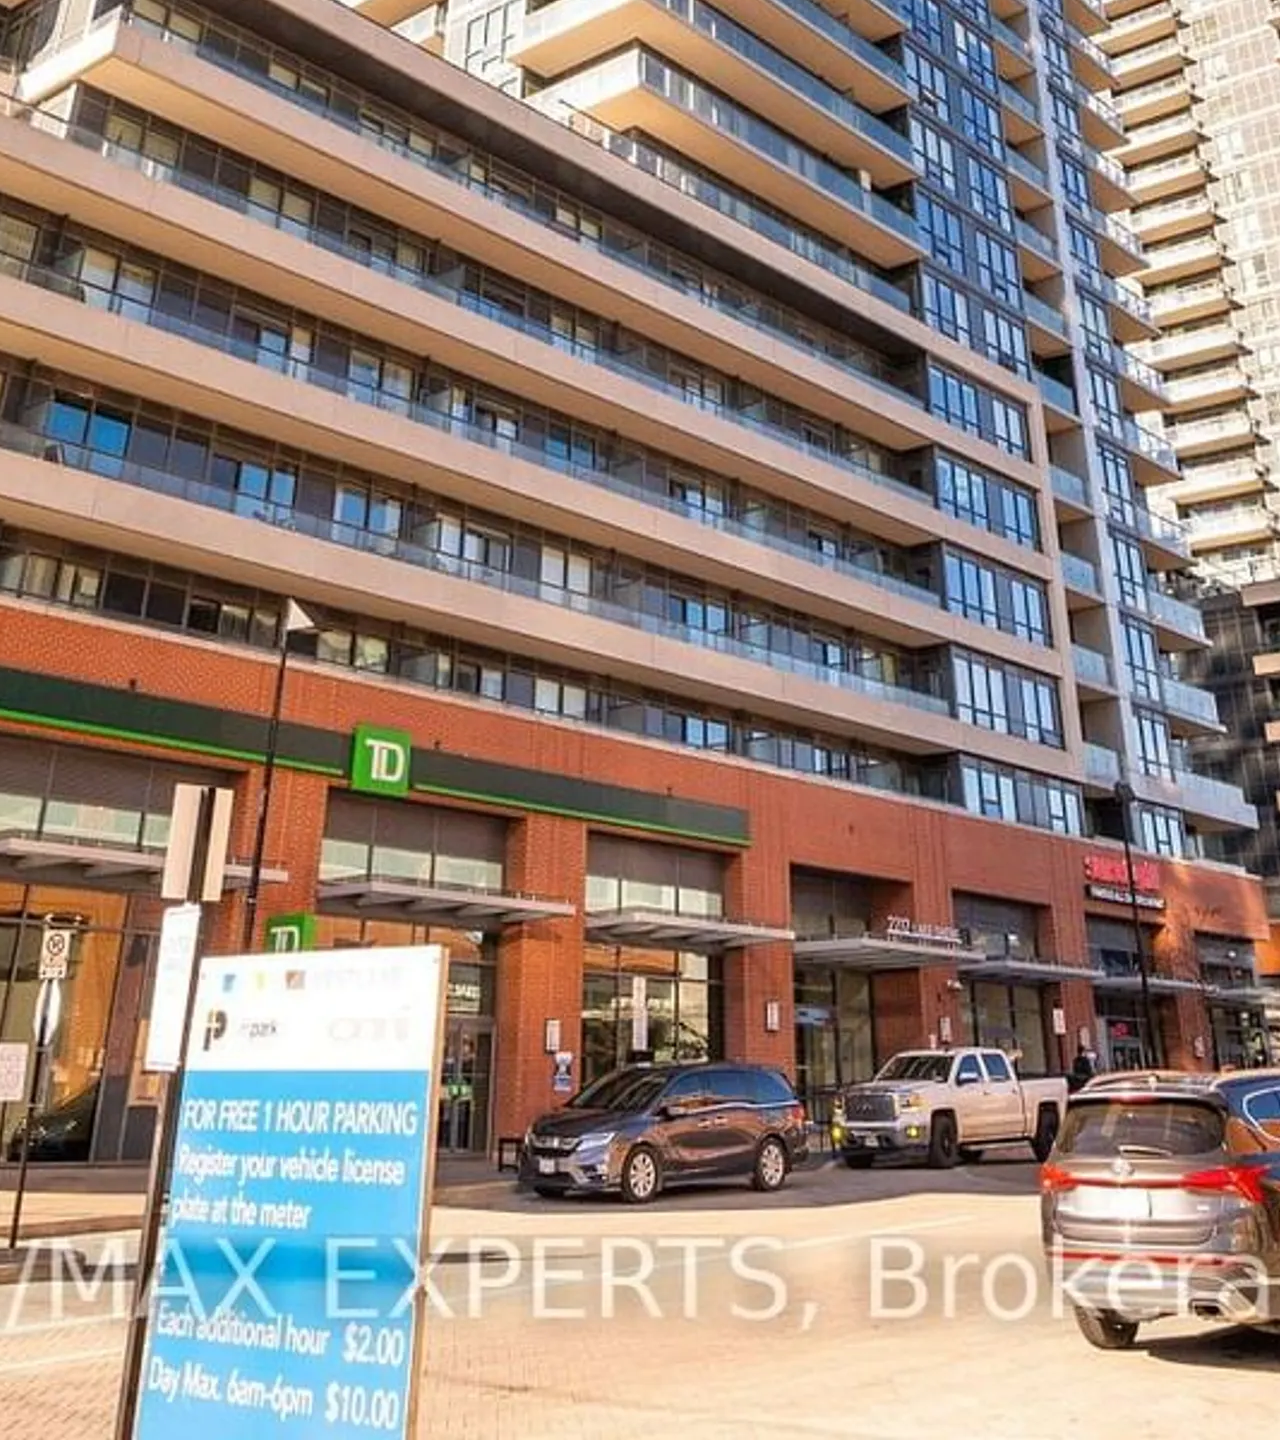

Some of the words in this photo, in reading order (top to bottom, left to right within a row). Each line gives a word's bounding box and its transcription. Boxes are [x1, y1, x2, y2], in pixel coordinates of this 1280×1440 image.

[364, 737, 407, 782] TD
[269, 924, 301, 951] TD
[184, 1099, 220, 1131] FOR
[221, 1100, 262, 1132] FREE
[263, 1101, 273, 1132] 1
[275, 1101, 331, 1134] HOUR
[333, 1101, 418, 1137] PARKING
[178, 1144, 238, 1182] Register
[239, 1154, 278, 1186] your
[279, 1148, 339, 1183] vehicle
[341, 1149, 406, 1187] license
[170, 1189, 211, 1228] plate
[211, 1198, 229, 1225] at
[230, 1191, 257, 1226] the
[260, 1201, 312, 1230] meter
[157, 1301, 193, 1336] Each
[196, 1307, 282, 1350] additional
[284, 1316, 332, 1356] hour
[343, 1321, 405, 1367] $2.00
[148, 1357, 179, 1402] Day
[226, 1369, 314, 1421] 6am-6pm
[325, 1380, 400, 1430] $10.00
